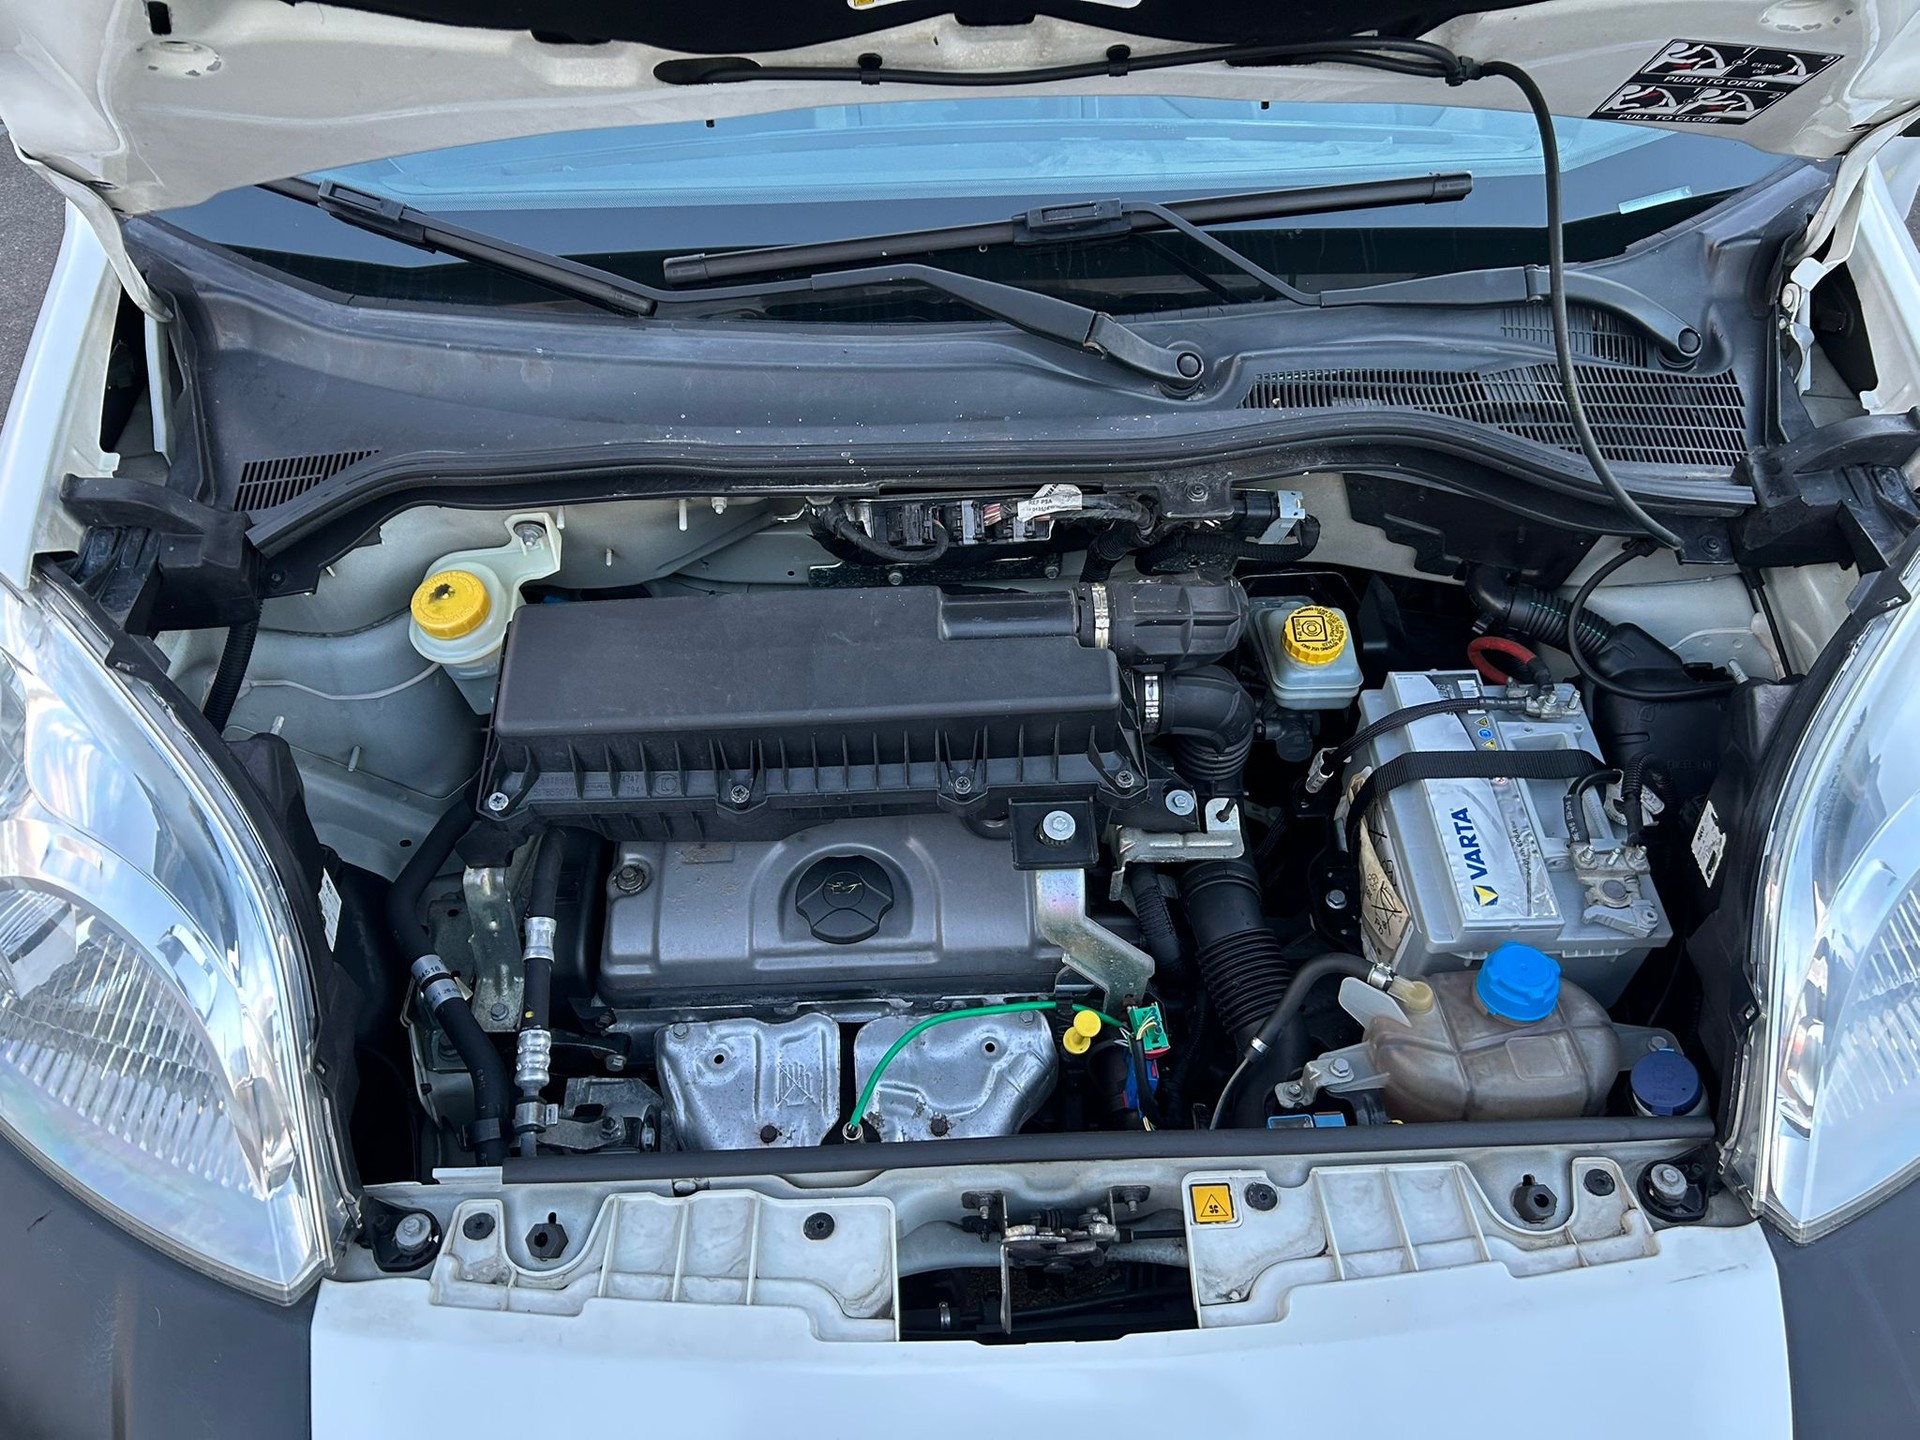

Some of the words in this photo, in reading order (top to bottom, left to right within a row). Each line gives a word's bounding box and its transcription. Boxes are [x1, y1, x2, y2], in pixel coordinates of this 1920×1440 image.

[1663, 75, 1703, 84] PUSH
[1705, 77, 1726, 85] TO
[1727, 80, 1767, 88] OPEN
[1617, 113, 1654, 121] PULL
[1673, 115, 1721, 123] CLOSE
[1450, 807, 1488, 880] VARTA
